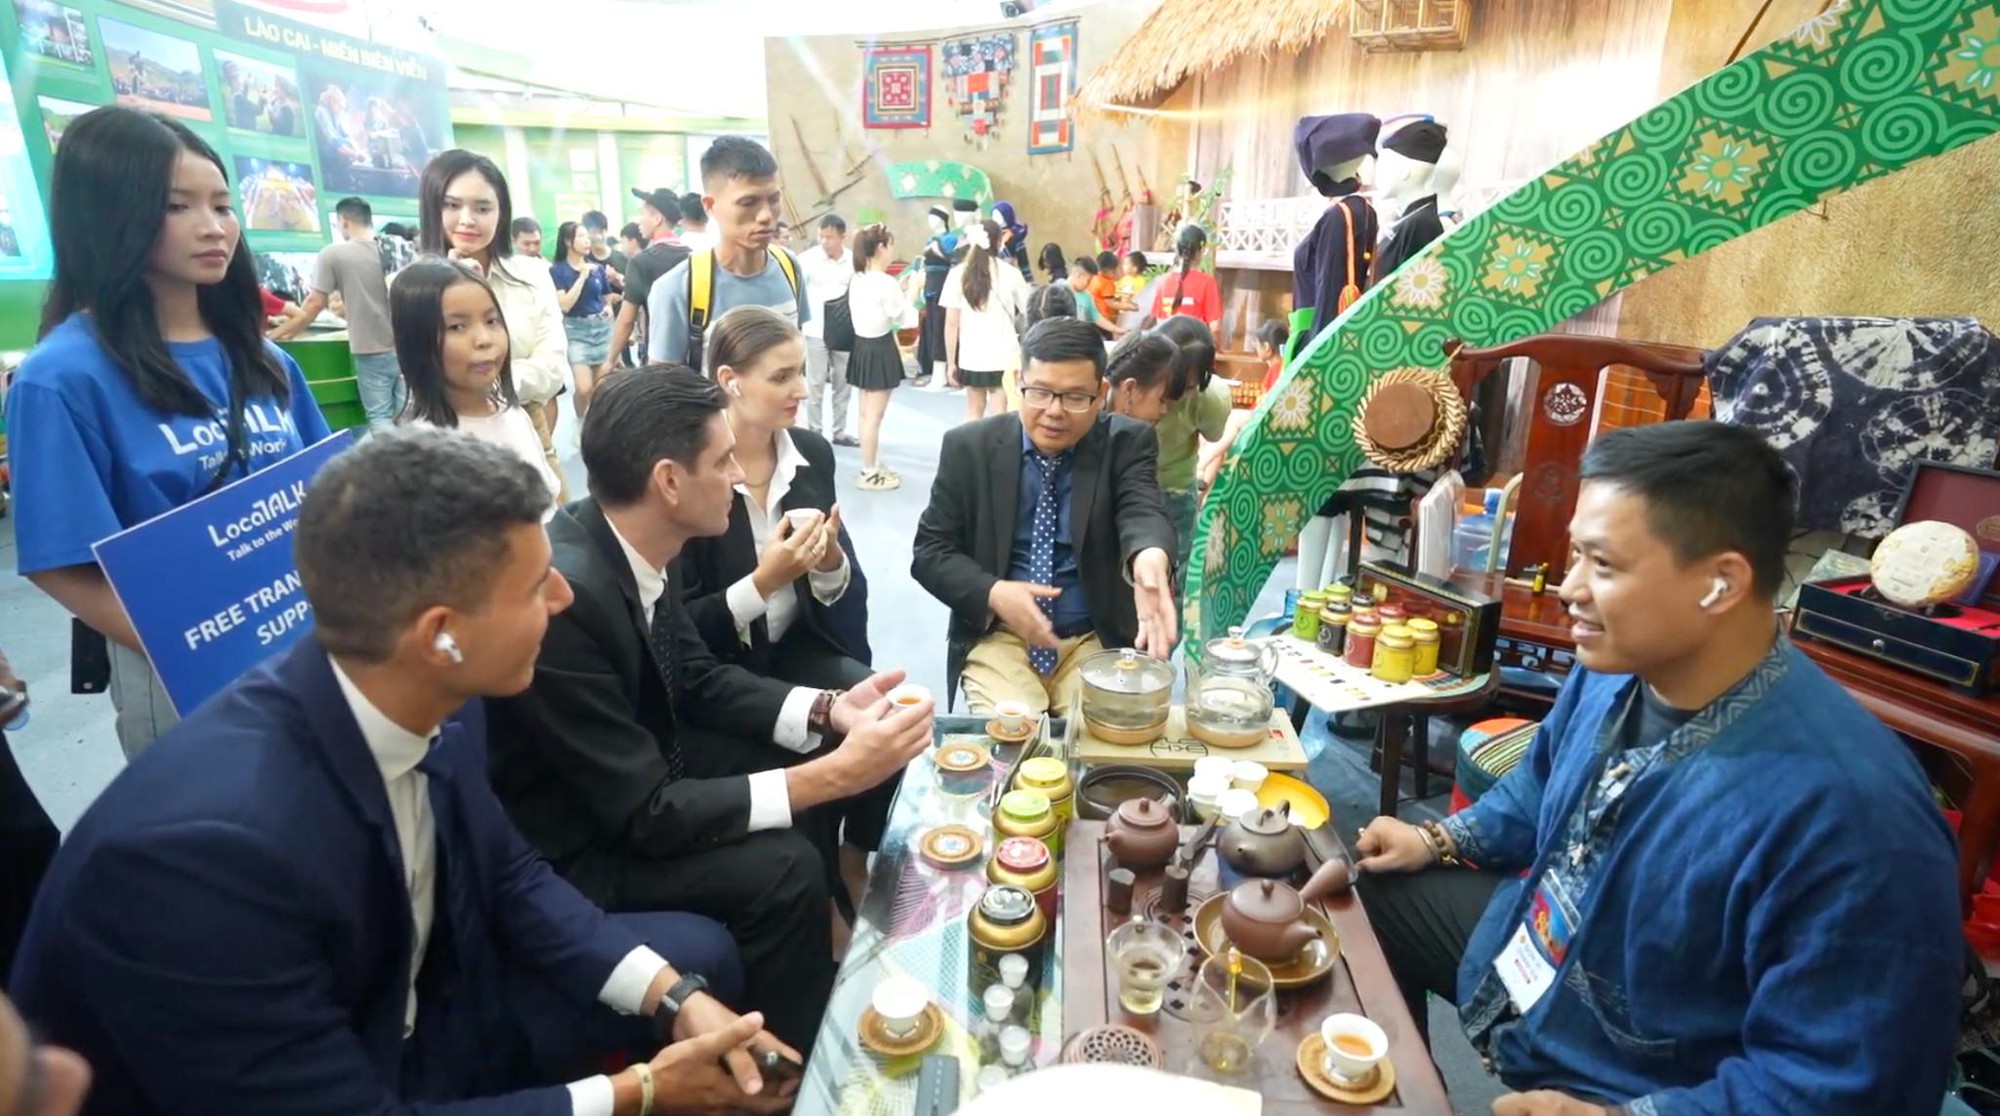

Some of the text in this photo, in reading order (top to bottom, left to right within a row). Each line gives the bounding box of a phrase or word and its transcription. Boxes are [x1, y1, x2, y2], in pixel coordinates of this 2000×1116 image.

[283, 27, 311, 50] CAI
[226, 541, 253, 562] Talk
[251, 537, 266, 549] to
[264, 526, 284, 543] the
[184, 569, 303, 651] FREE TRAN
[256, 601, 314, 646] SUPP
